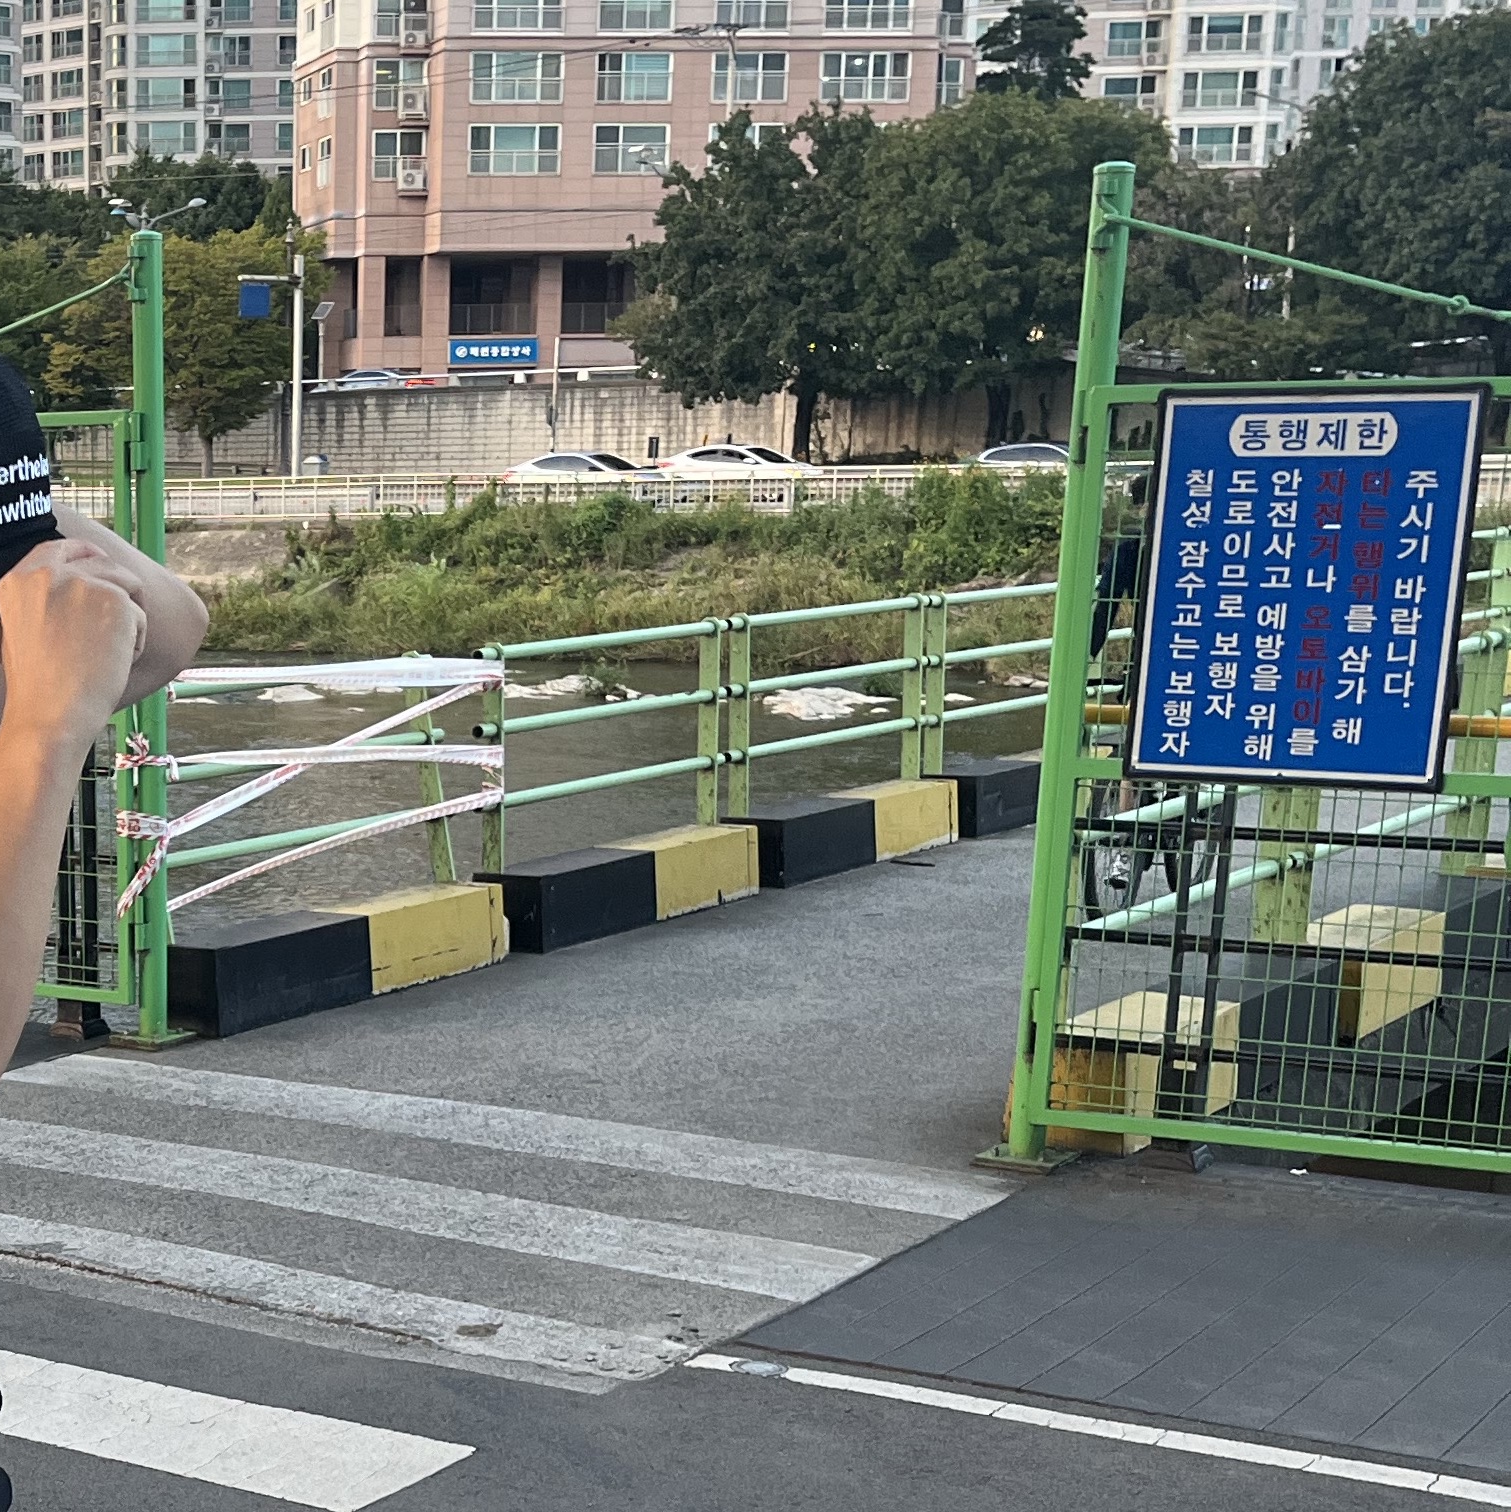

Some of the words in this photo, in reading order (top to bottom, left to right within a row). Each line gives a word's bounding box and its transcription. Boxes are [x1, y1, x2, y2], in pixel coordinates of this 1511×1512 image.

[1238, 418, 1389, 452] 통행제한
[1181, 469, 1214, 529] 칠성
[1214, 469, 1259, 620] 도로이므로
[1259, 468, 1302, 590] 안전사고
[1306, 469, 1348, 593] 자전거나
[1357, 469, 1393, 530] 타는
[1396, 469, 1439, 564] 주시기
[1169, 540, 1207, 660] 잠수교는
[1344, 541, 1384, 633] 행위를
[1204, 632, 1242, 719] 보행자
[1250, 603, 1287, 691] 예방을
[1287, 605, 1332, 756] 오토바이를
[1383, 575, 1426, 708] 바랍니다.
[1159, 671, 1195, 758] 보행자
[1244, 703, 1275, 760] 위해
